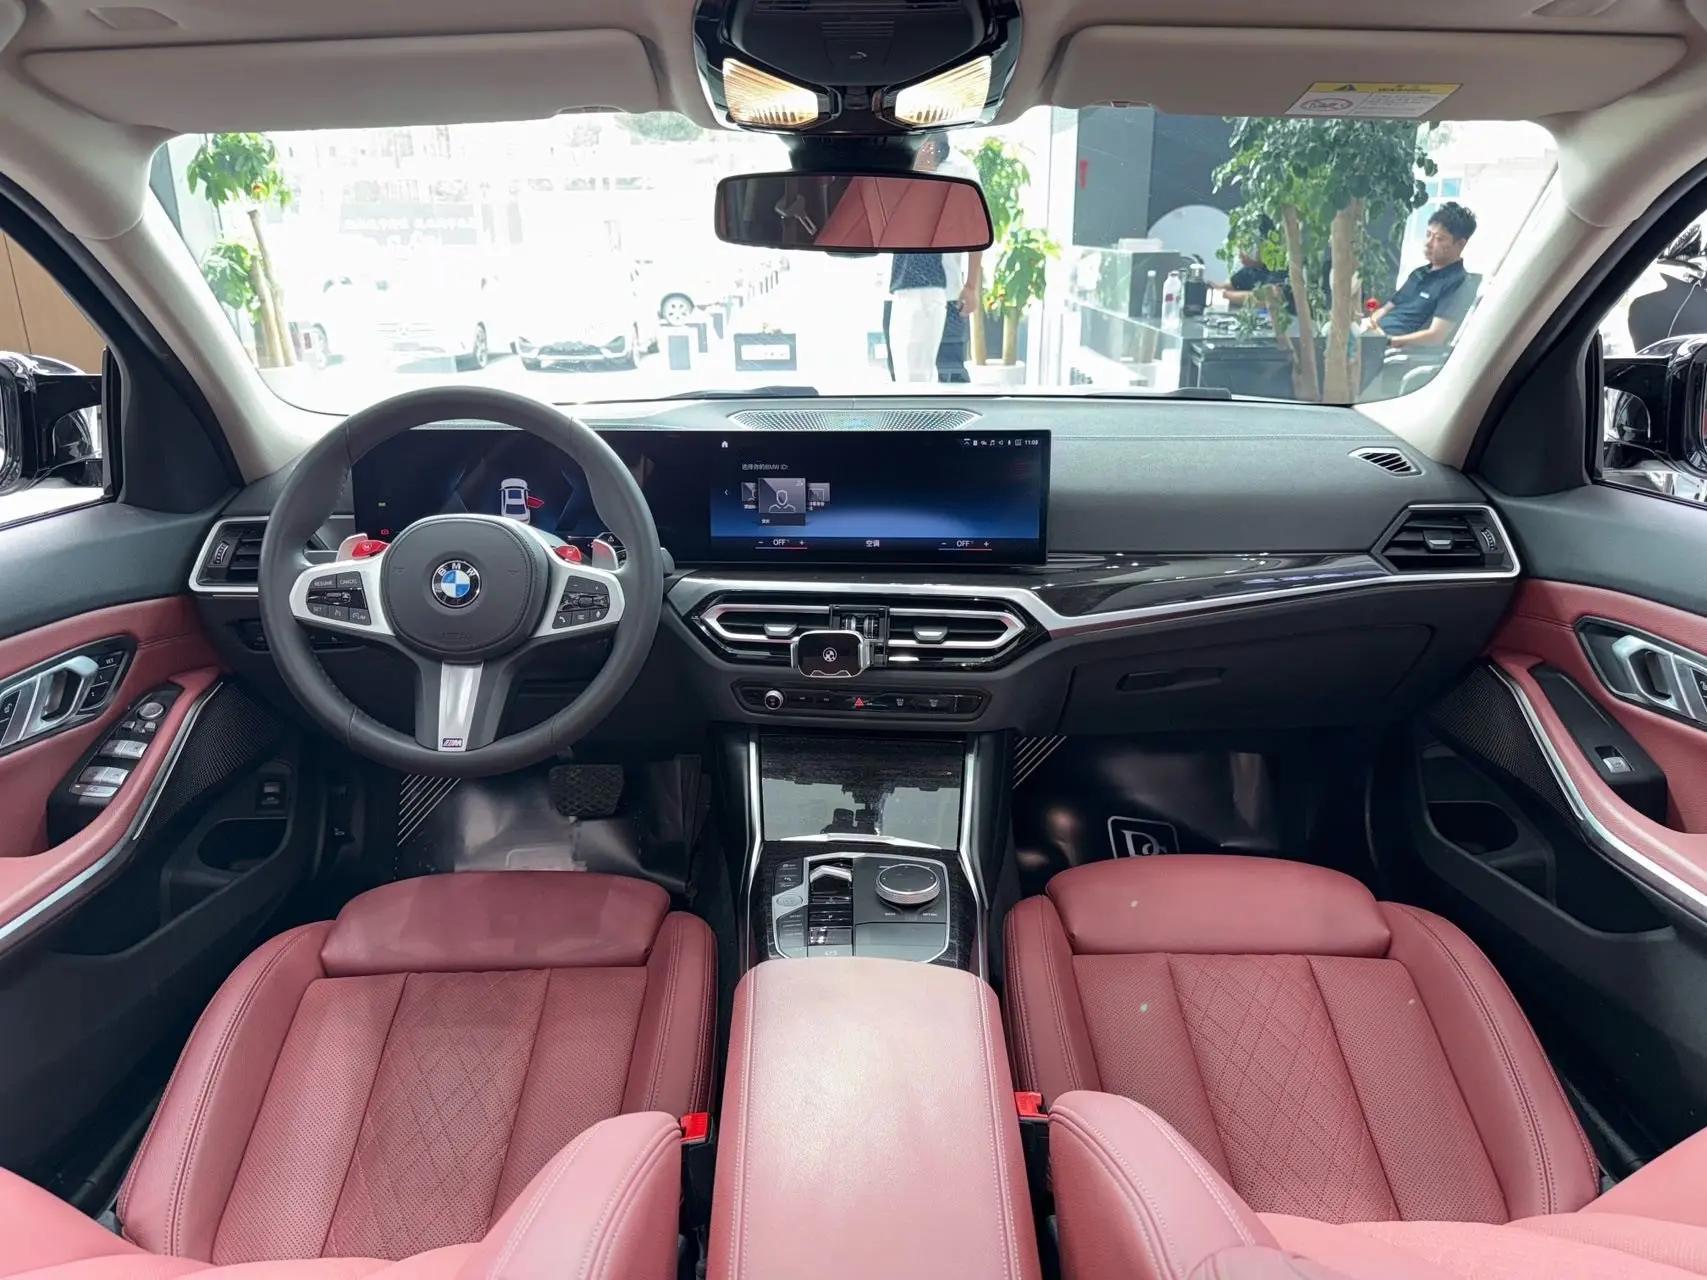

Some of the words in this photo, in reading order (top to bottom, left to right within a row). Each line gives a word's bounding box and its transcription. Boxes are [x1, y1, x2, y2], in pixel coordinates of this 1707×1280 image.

[772, 538, 786, 546] OFF
[865, 539, 880, 548] 空调
[956, 539, 970, 548] OFF
[437, 562, 477, 577] BMW
